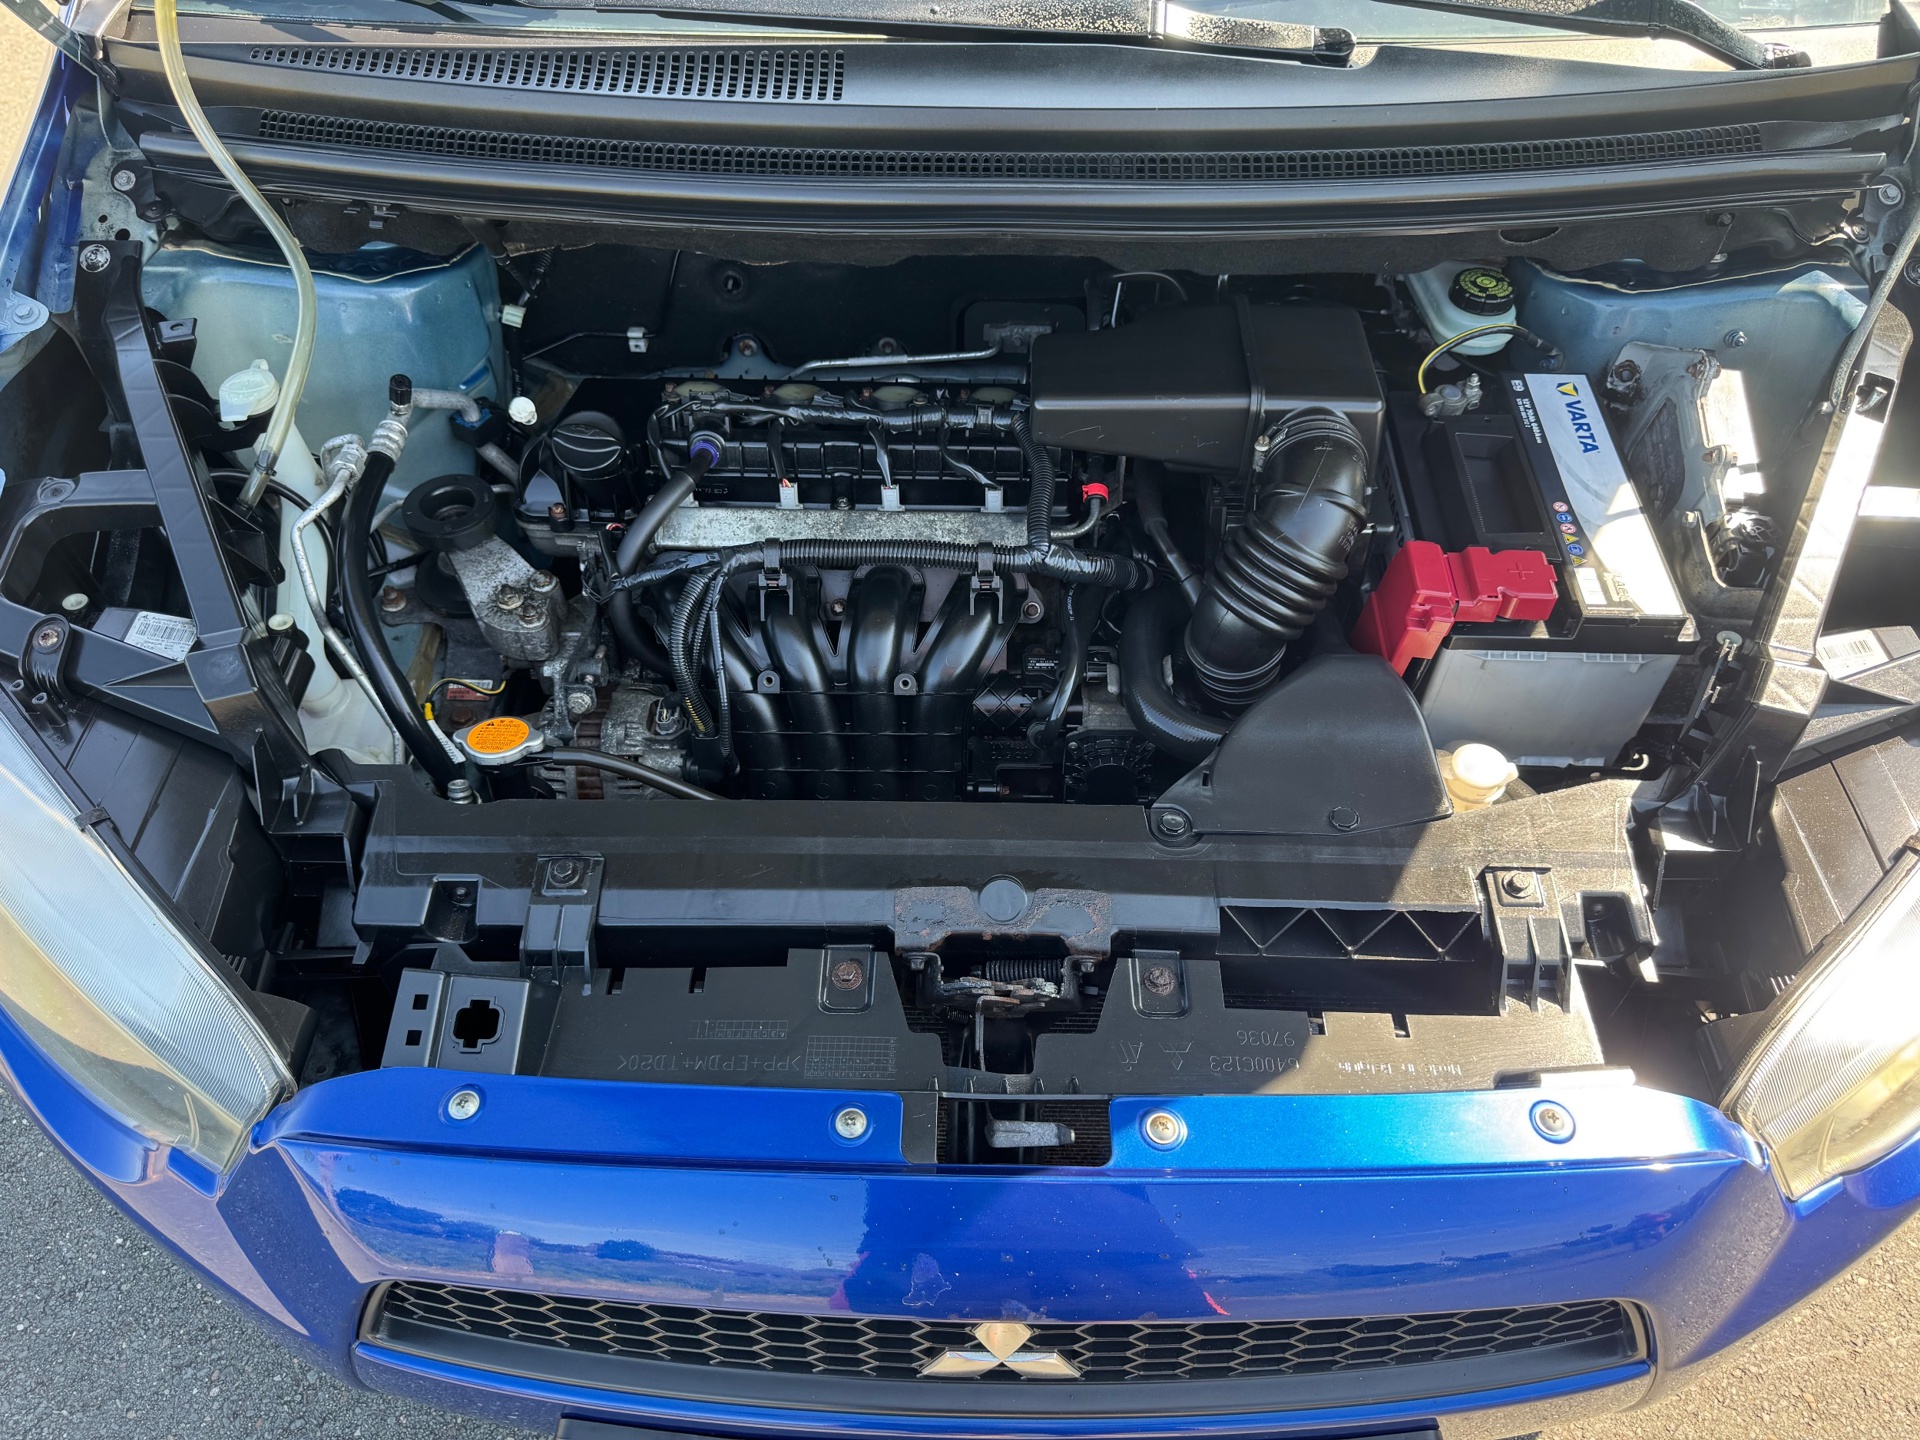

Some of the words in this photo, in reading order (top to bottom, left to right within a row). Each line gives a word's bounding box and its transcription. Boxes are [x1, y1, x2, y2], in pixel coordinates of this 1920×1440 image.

[1511, 380, 1525, 391] E9
[1565, 400, 1599, 454] VARTA
[1236, 1030, 1295, 1047] 97036
[1209, 1055, 1299, 1072] 6400C123
